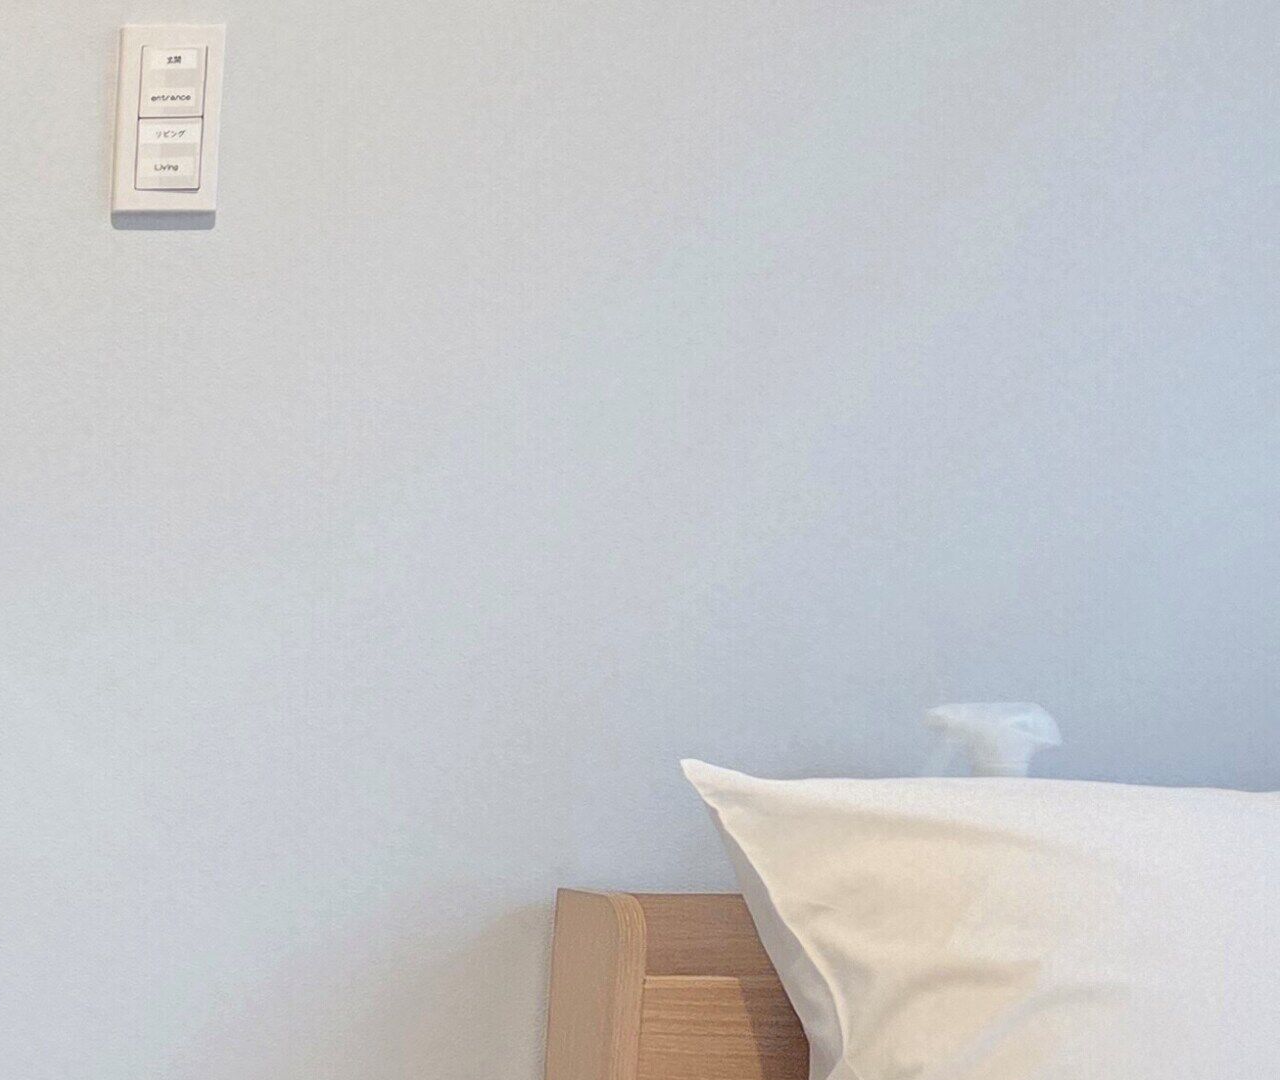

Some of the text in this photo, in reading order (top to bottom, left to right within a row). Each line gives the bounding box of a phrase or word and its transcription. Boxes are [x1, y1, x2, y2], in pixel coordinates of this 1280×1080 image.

[151, 93, 191, 102] entrance
[156, 129, 186, 138] リビング
